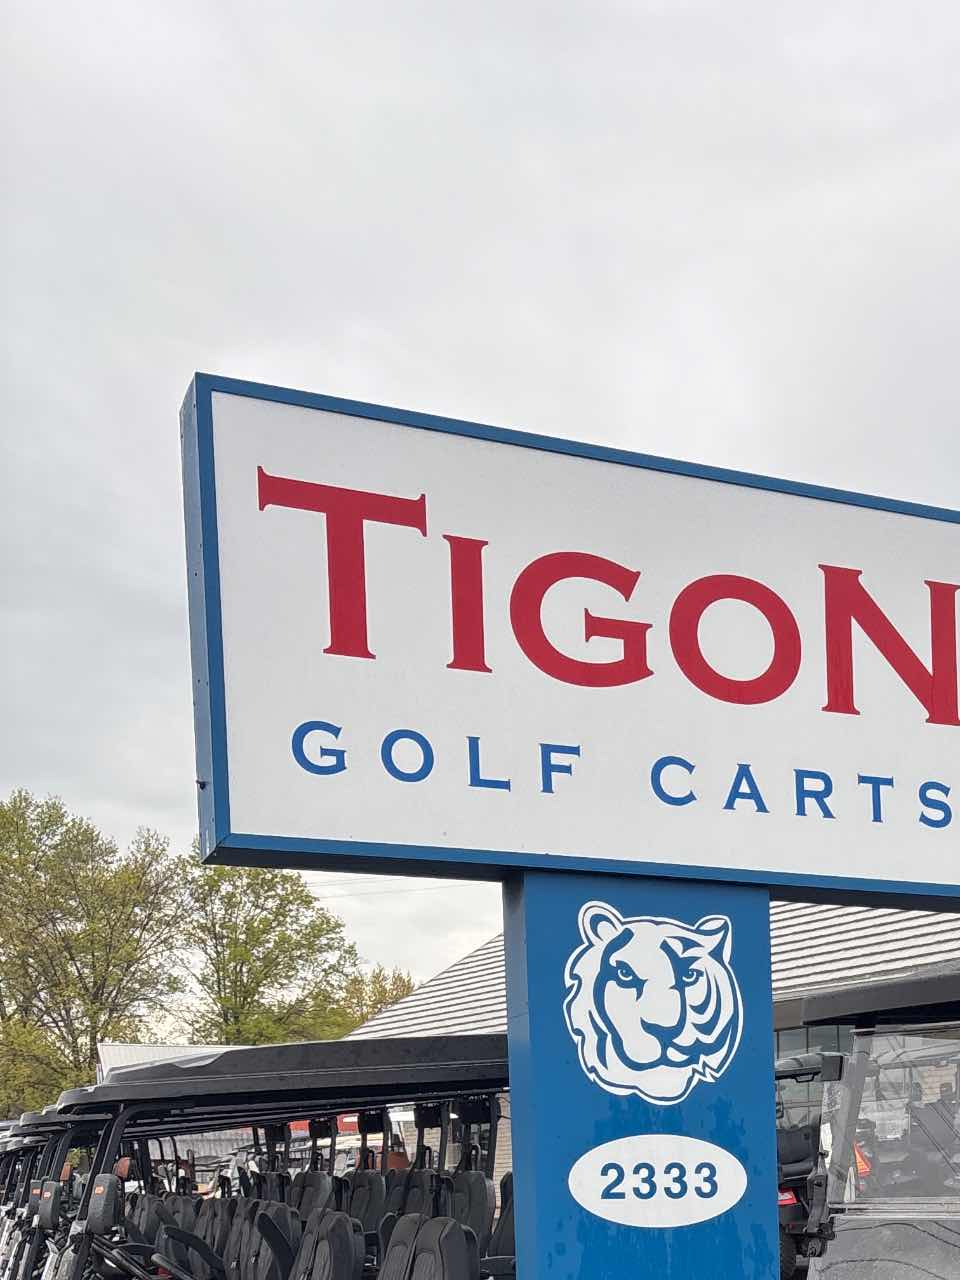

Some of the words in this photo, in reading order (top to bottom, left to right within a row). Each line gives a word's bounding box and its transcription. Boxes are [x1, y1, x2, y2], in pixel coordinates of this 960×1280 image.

[291, 720, 581, 794] GOLF
[650, 755, 953, 829] CARTS
[600, 1162, 718, 1199] 2333
